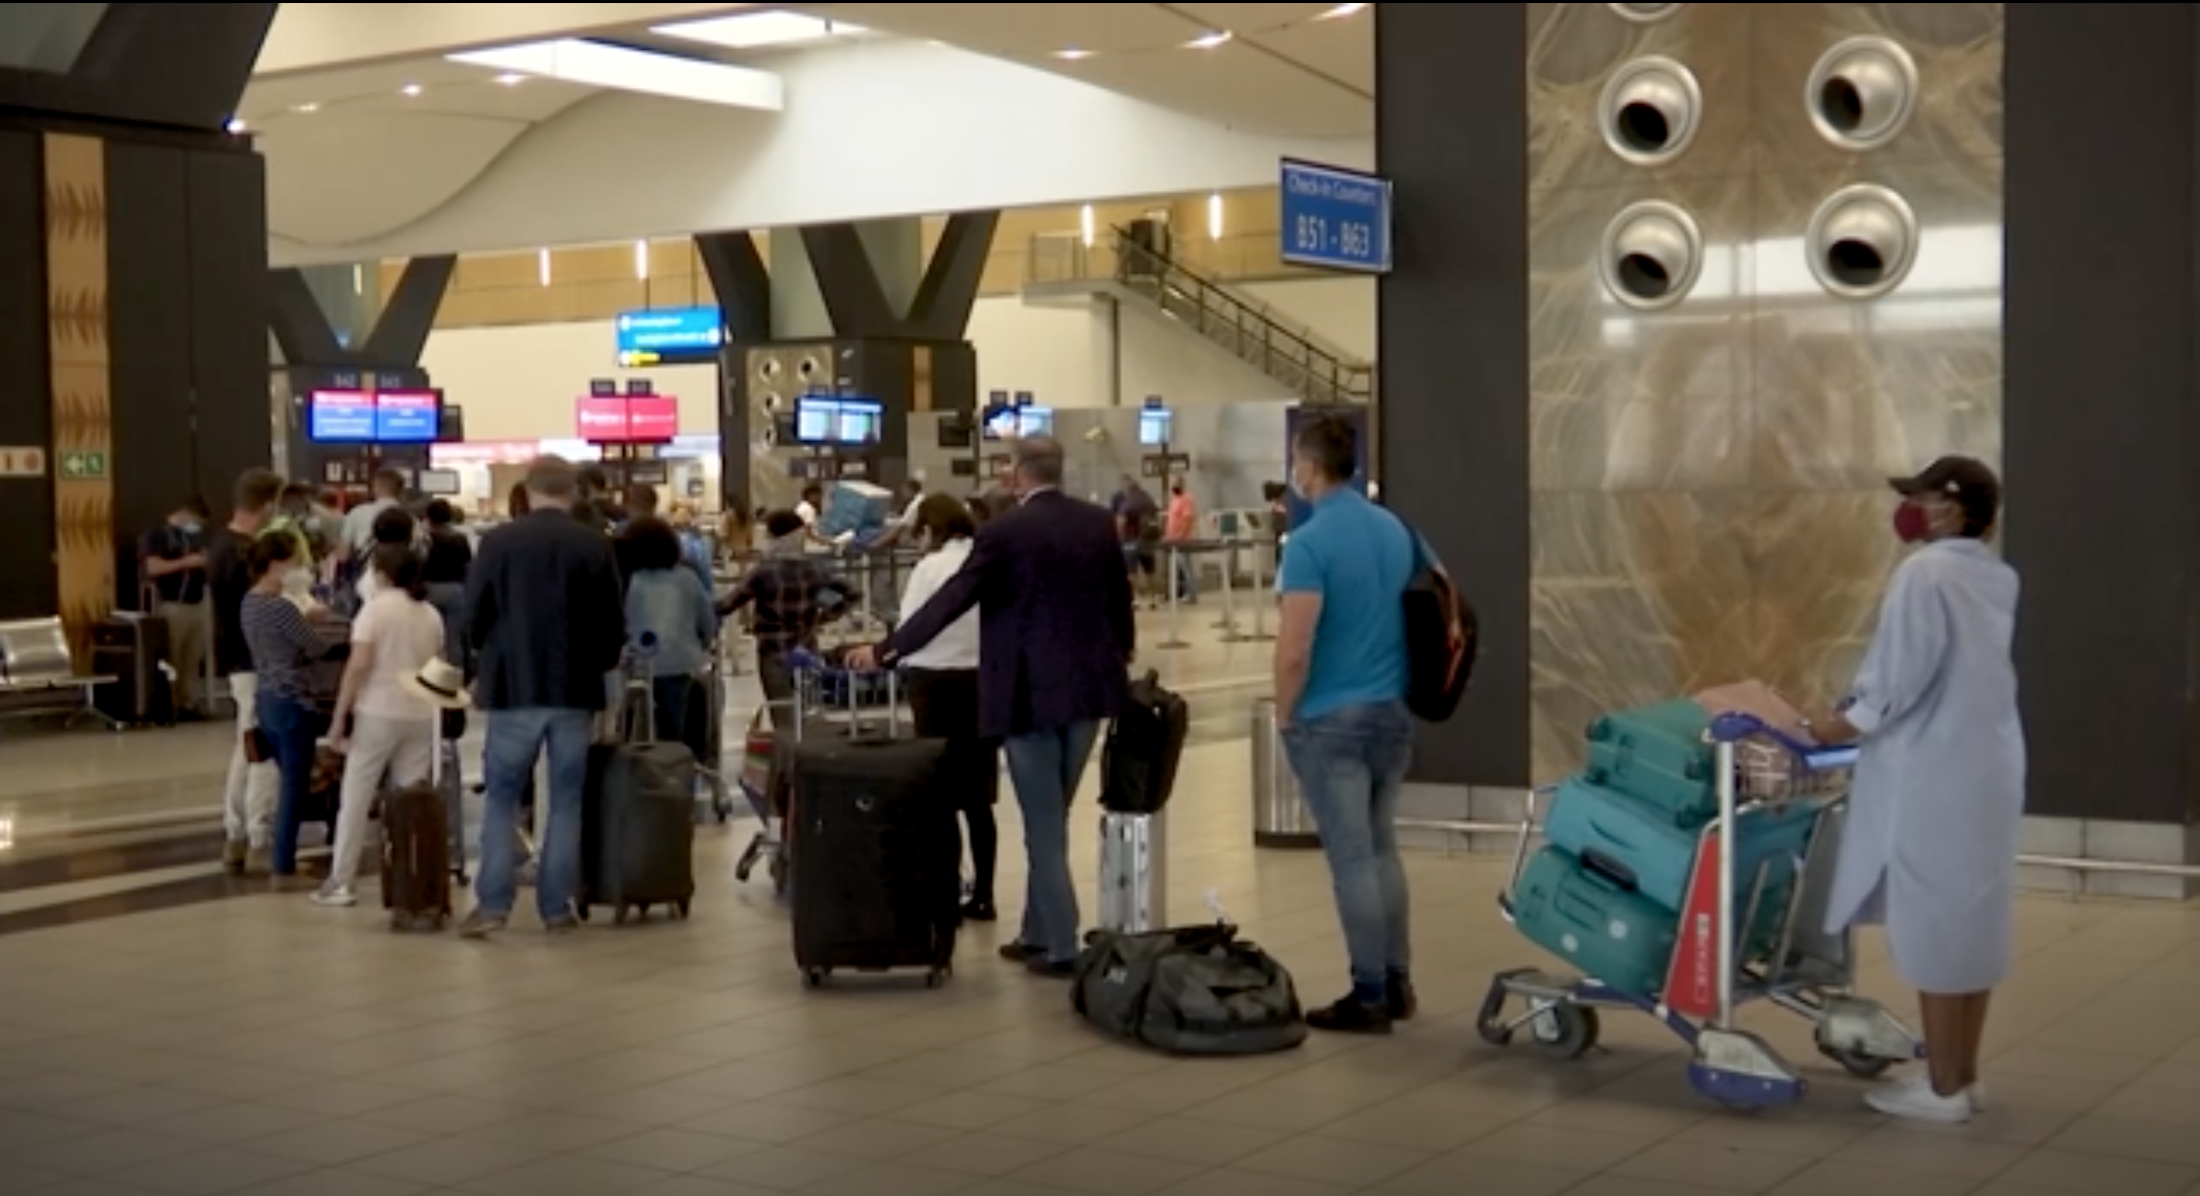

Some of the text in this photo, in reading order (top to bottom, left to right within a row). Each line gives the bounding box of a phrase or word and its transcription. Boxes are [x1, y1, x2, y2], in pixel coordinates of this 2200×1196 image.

[1287, 172, 1376, 207] Check-in Counters
[1298, 213, 1327, 252] B51
